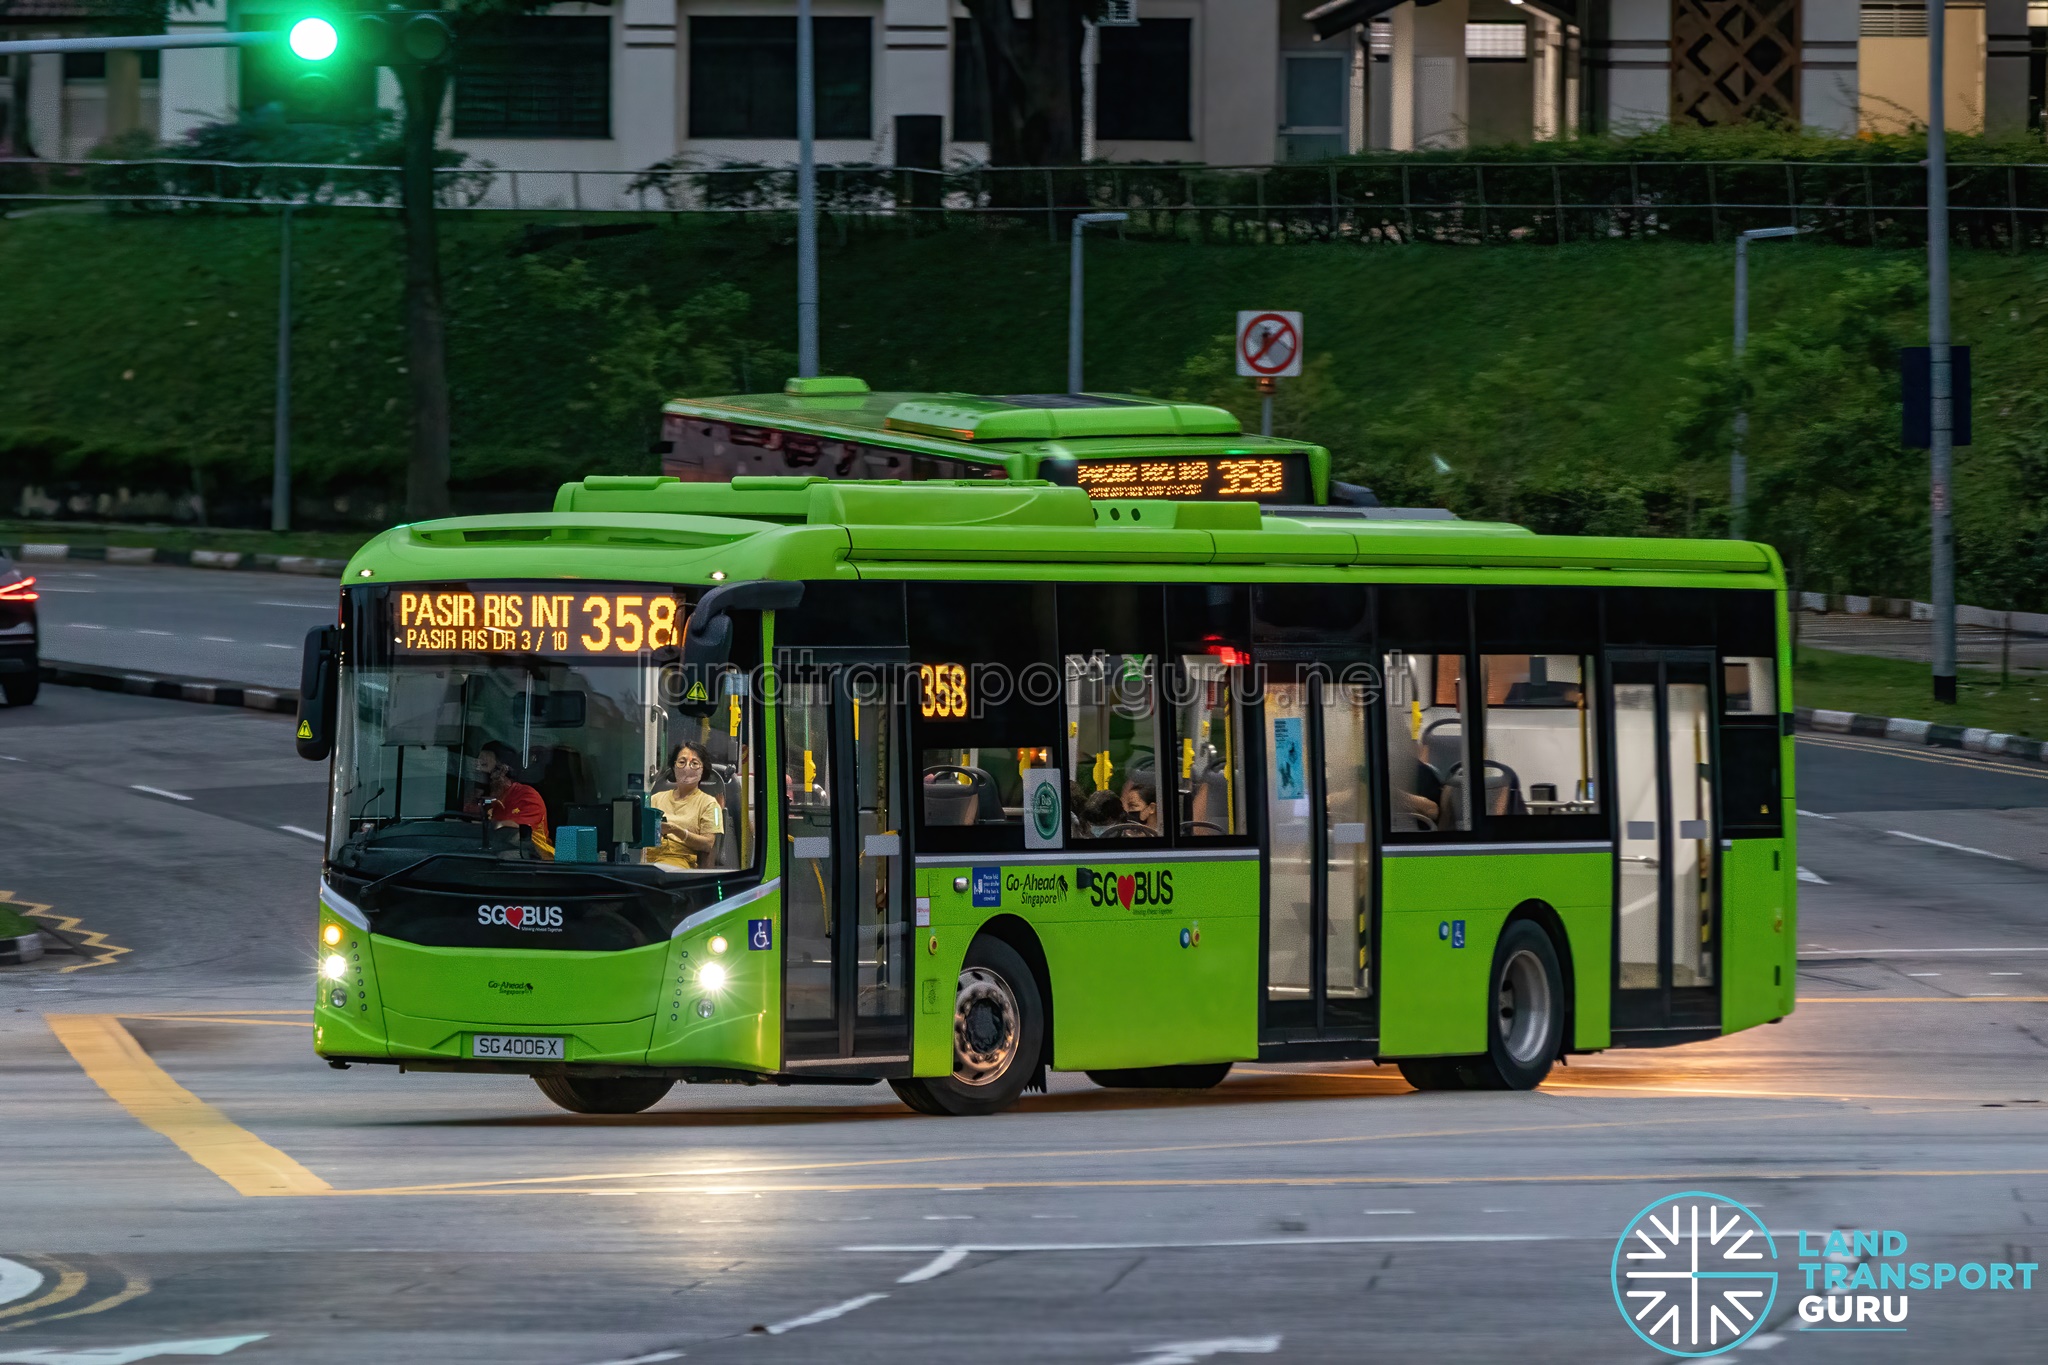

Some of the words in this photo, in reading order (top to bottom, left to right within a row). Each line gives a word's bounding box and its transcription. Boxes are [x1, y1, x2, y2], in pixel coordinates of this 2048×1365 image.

[401, 593, 475, 627] PASIR
[483, 595, 524, 628] RIS
[531, 595, 574, 628] INT
[581, 595, 678, 652] 358
[406, 629, 457, 649] PASIR
[462, 629, 488, 650] RIS
[493, 630, 516, 650] DR
[521, 630, 531, 651] 3
[552, 631, 568, 651] 10
[920, 664, 968, 717] 358
[1005, 873, 1056, 893] Go-Ahead
[1020, 891, 1057, 908] Singapore
